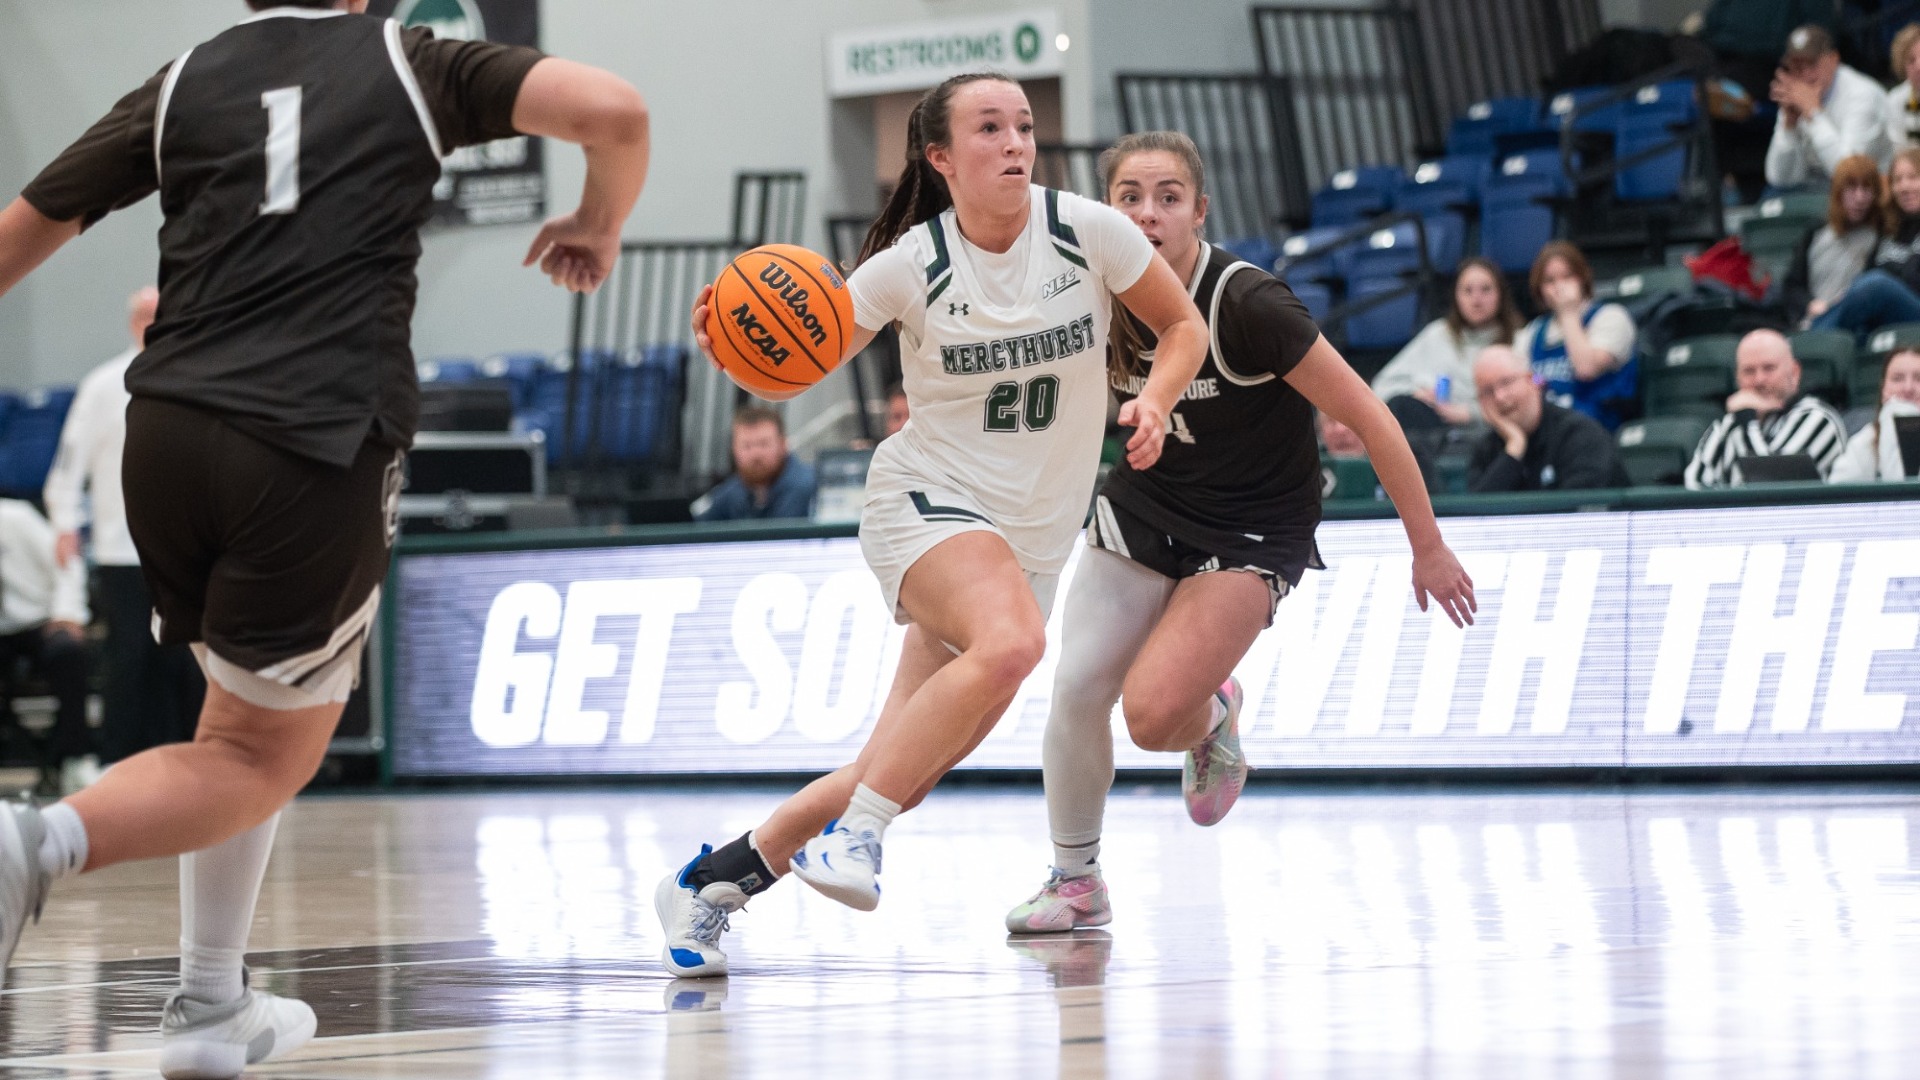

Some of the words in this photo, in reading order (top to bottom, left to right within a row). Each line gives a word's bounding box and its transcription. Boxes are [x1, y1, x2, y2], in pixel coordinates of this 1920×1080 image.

[847, 31, 1004, 75] RESTROOMS
[259, 85, 302, 216] 1
[759, 261, 827, 347] Wilson
[1042, 267, 1076, 299] NEC
[730, 302, 791, 367] NCAA
[940, 313, 1095, 375] MERCYHURST
[983, 374, 1060, 432] 20
[470, 576, 704, 748] GET
[1643, 540, 1920, 734] THE
